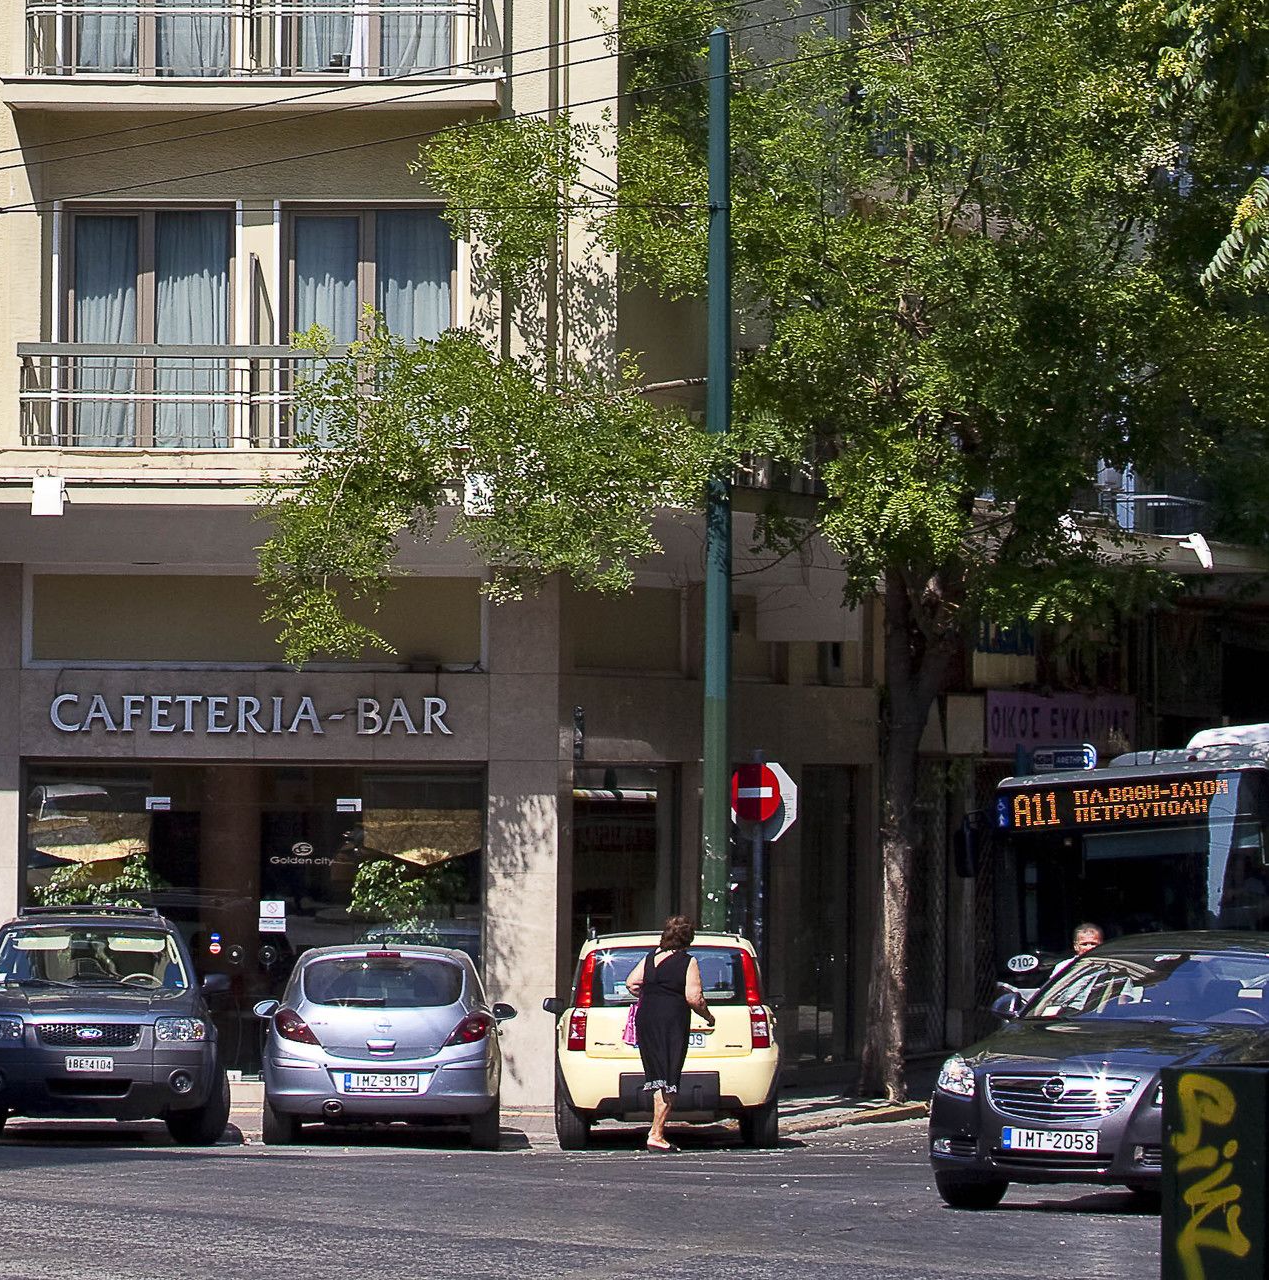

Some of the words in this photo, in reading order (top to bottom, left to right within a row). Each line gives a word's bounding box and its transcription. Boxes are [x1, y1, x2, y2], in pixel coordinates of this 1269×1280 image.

[1073, 798, 1208, 824] ΠΕΤΡΟΥΠΟΛΗ
[270, 856, 313, 865] Golden
[1010, 957, 1035, 969] 9102
[356, 1075, 416, 1087] IMZ-9187
[1017, 1130, 1095, 1151] IMT-2058
